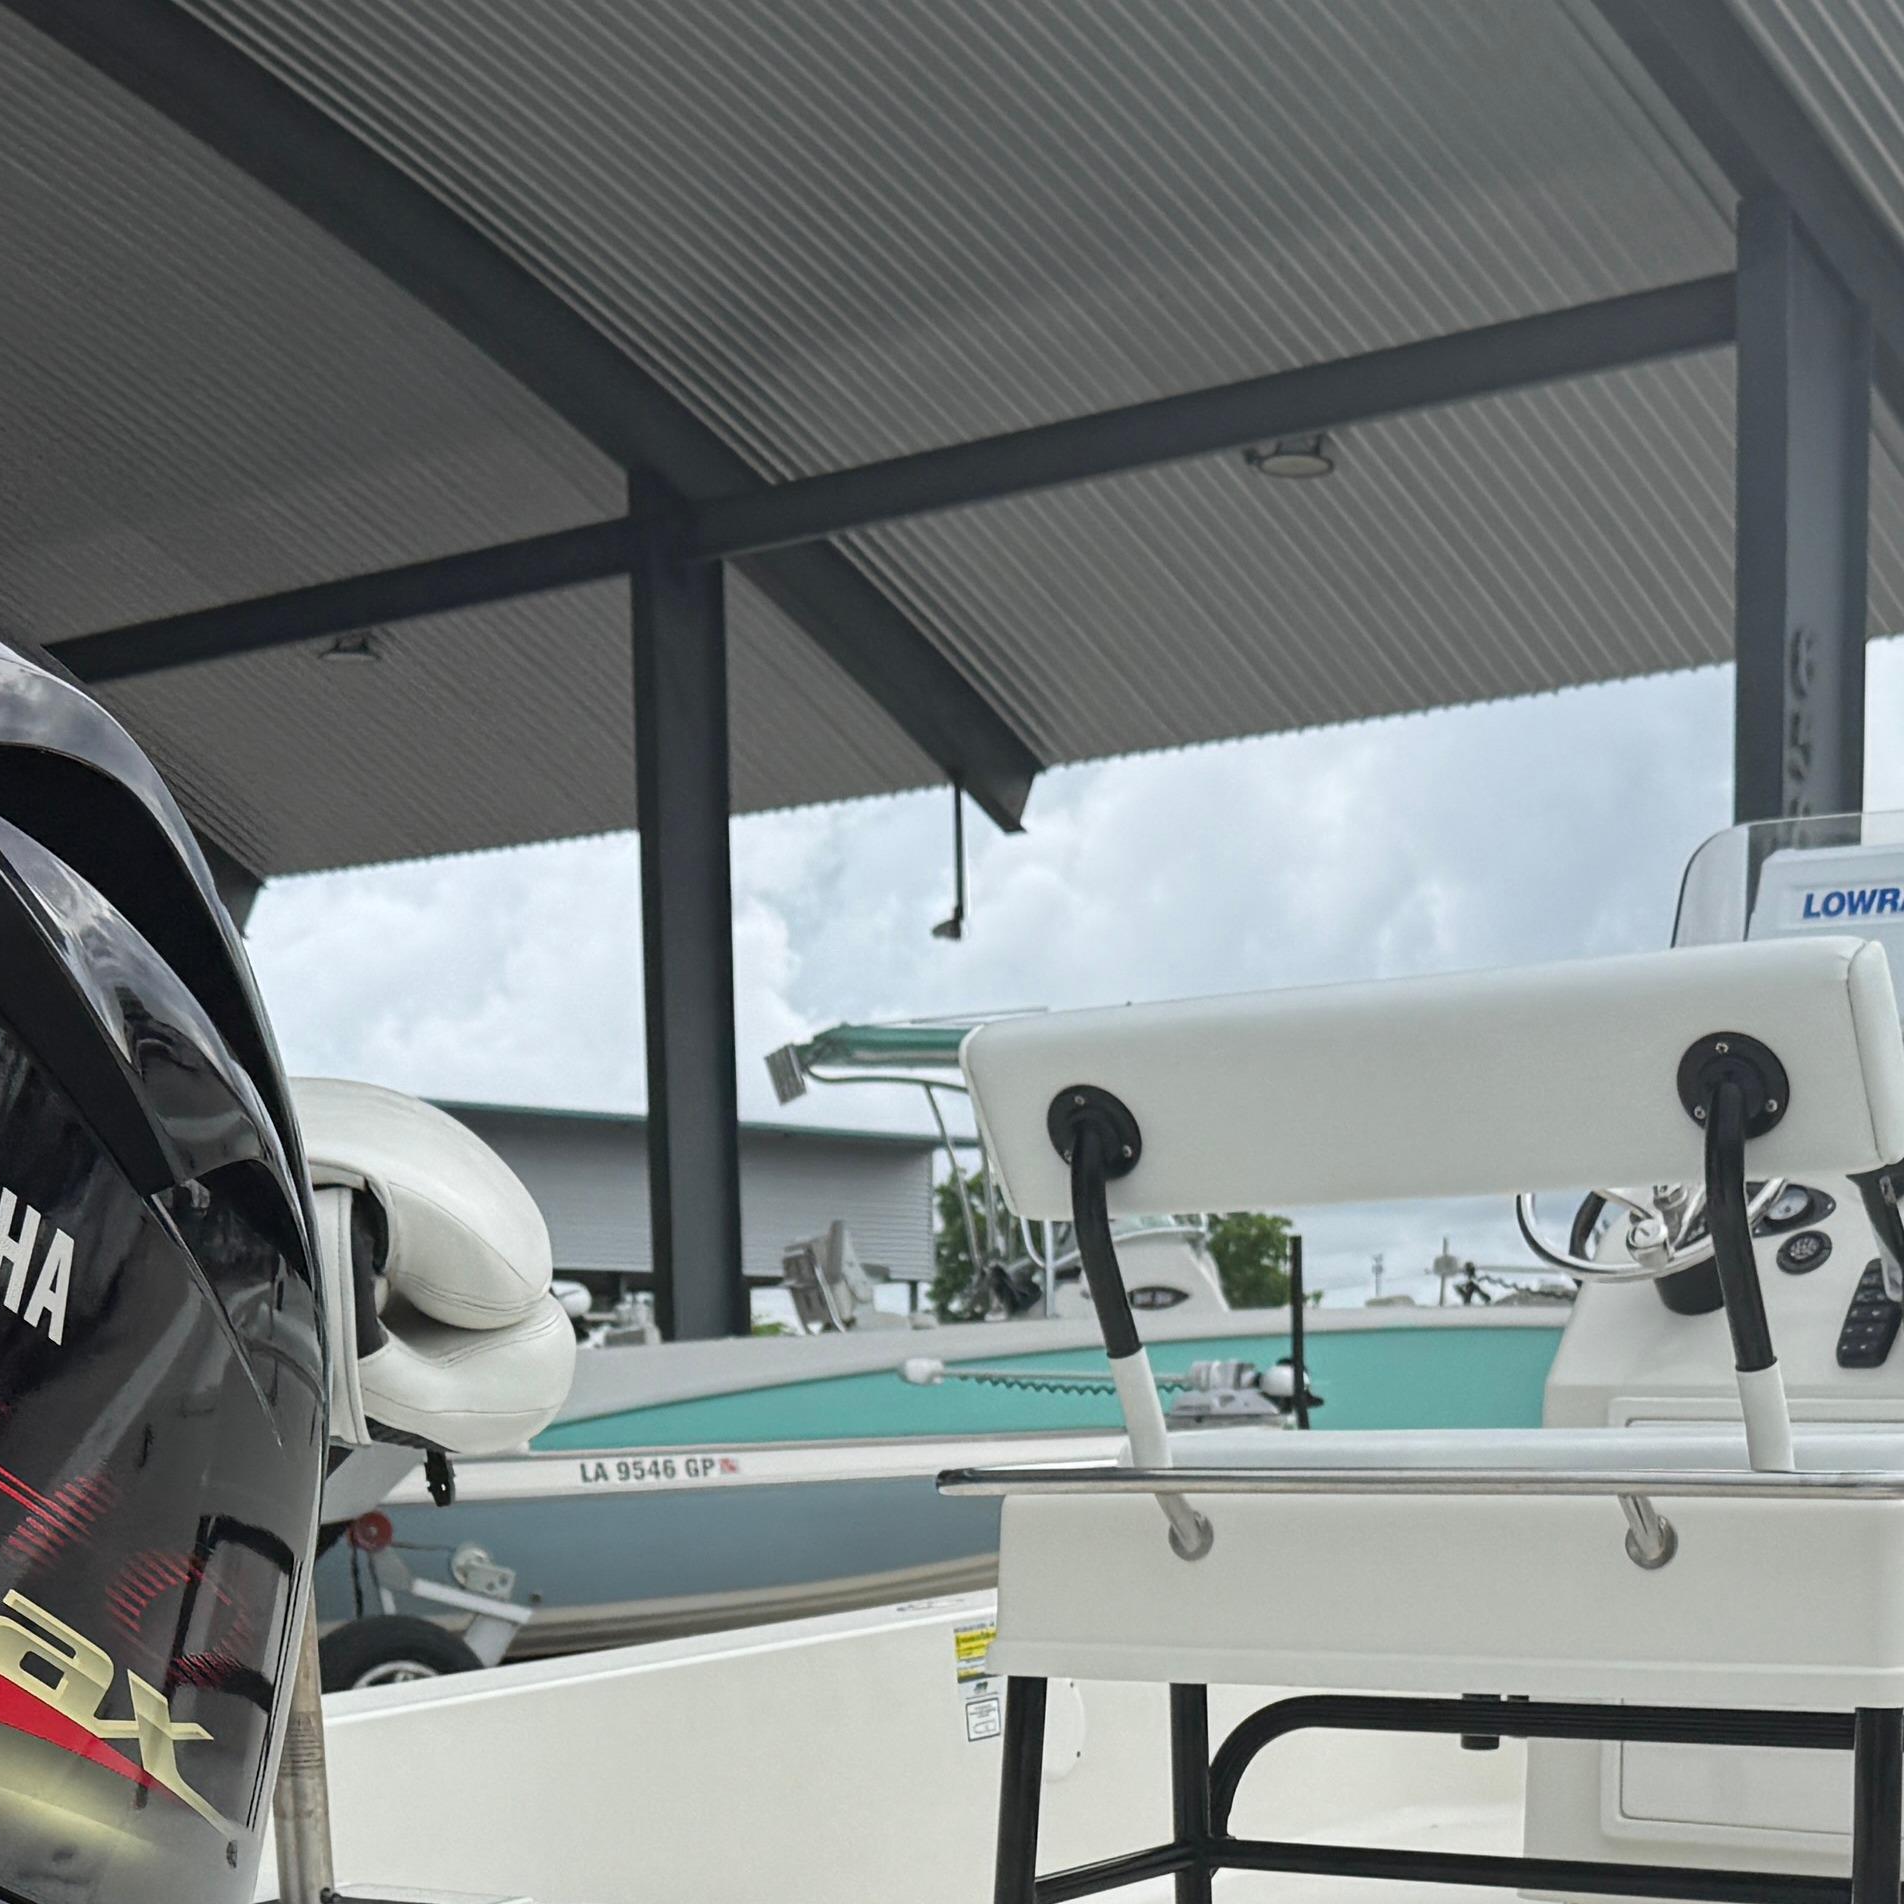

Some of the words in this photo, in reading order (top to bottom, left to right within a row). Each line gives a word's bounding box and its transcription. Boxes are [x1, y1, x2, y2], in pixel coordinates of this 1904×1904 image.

[580, 1462, 608, 1483] LA
[616, 1459, 676, 1482] 9546
[685, 1458, 715, 1478] GP
